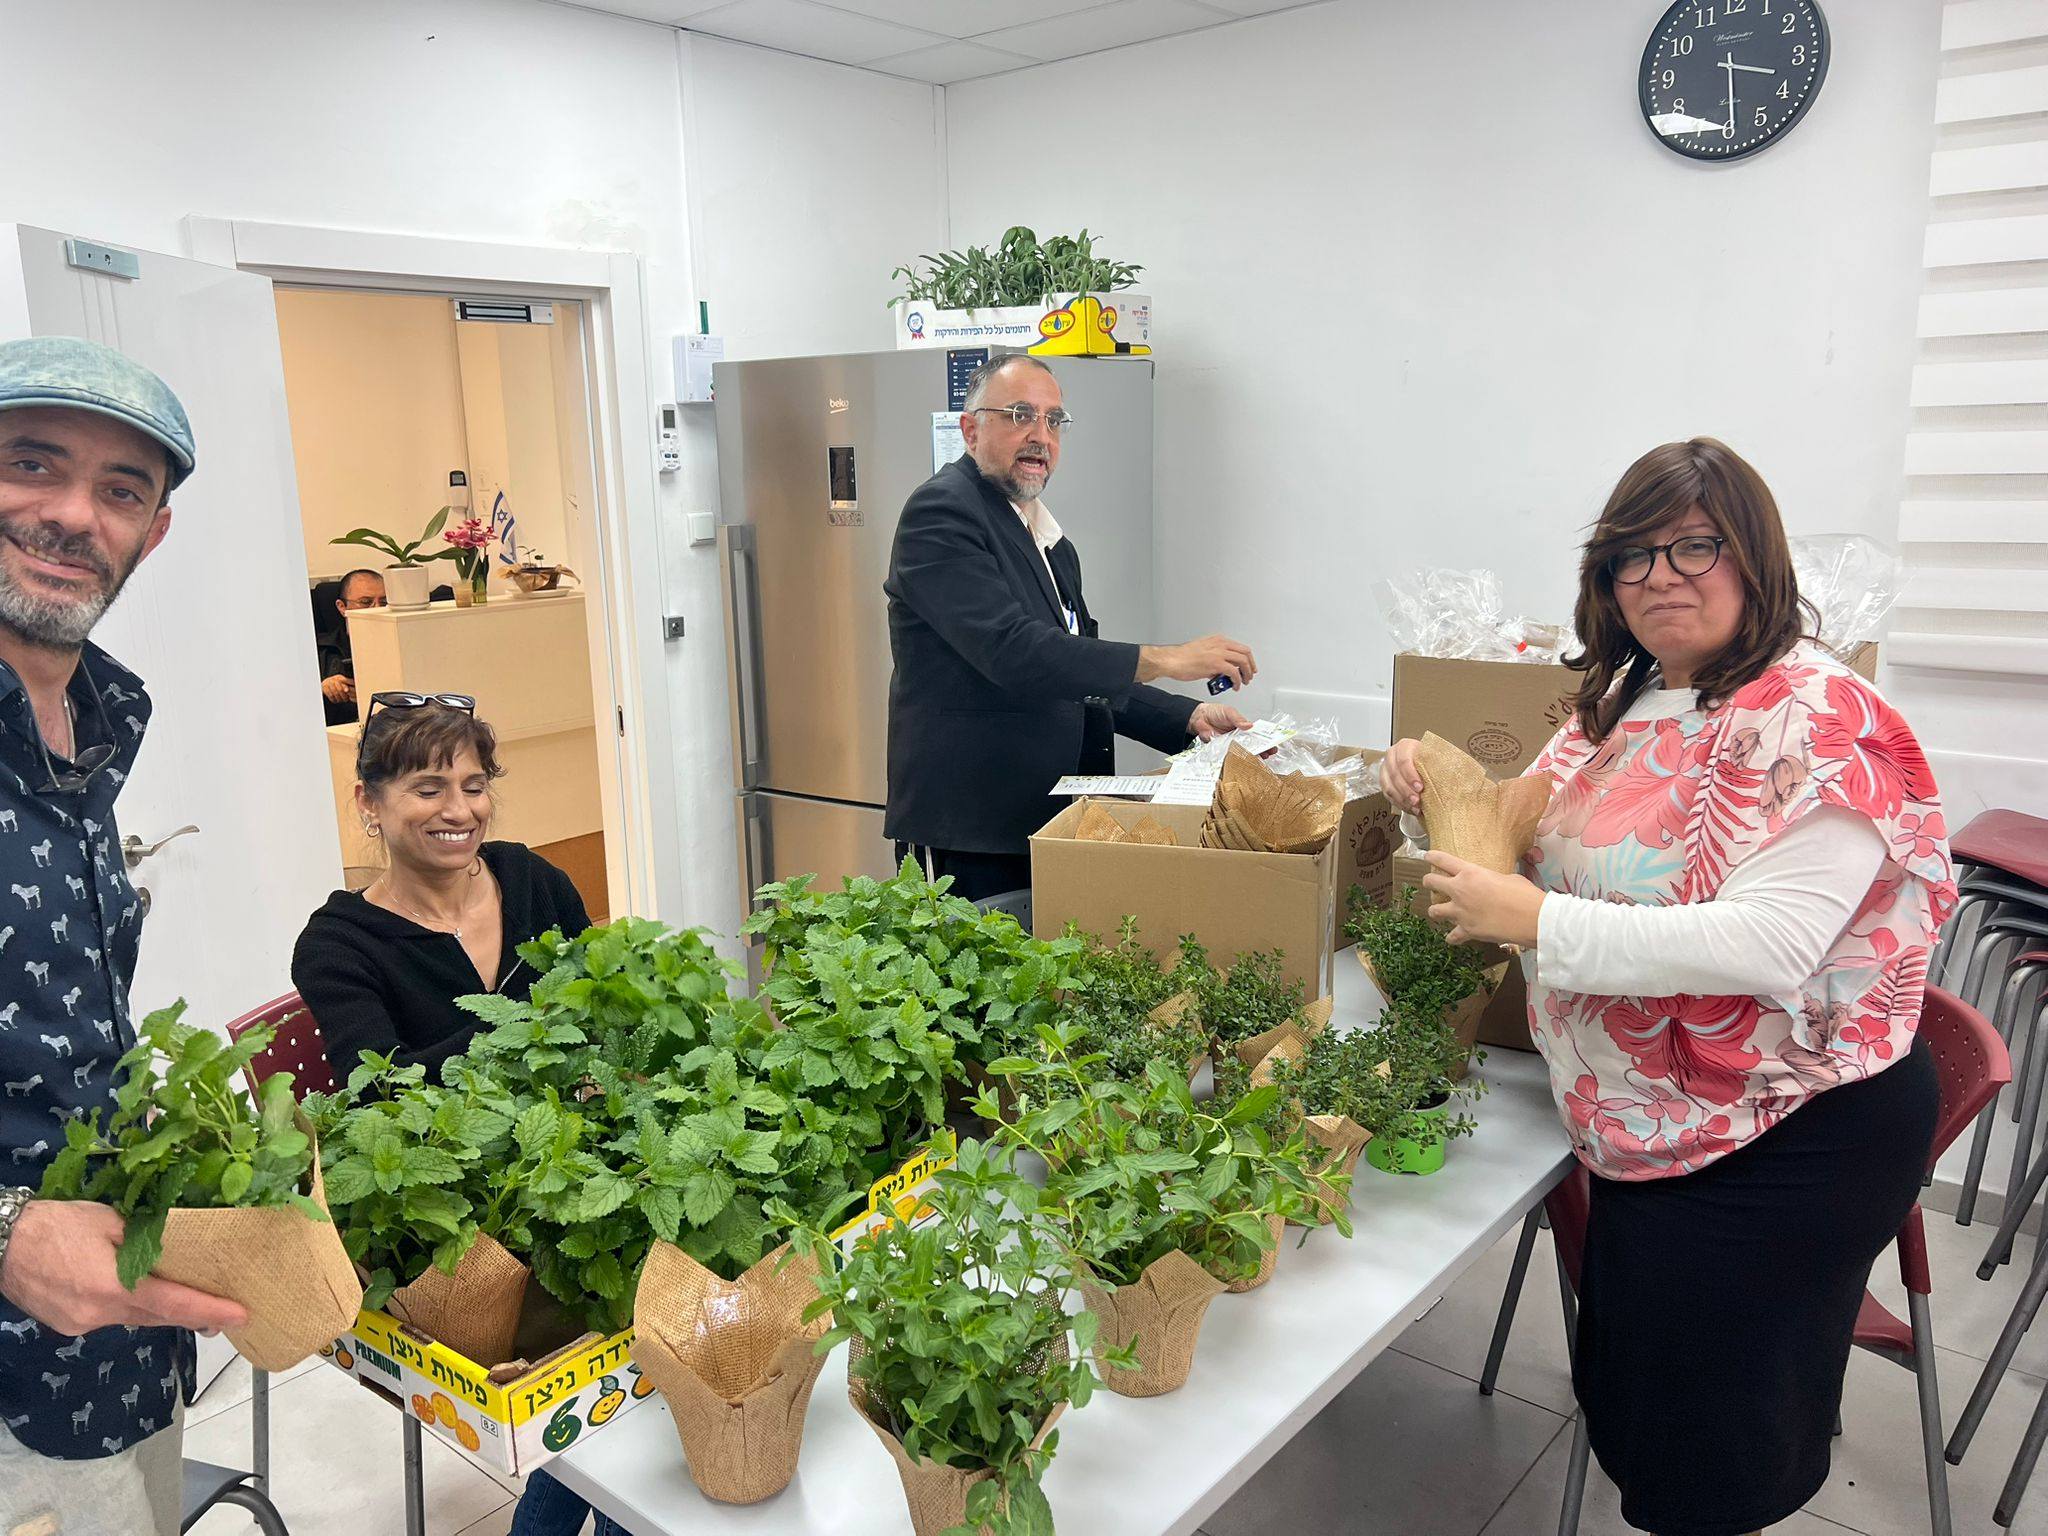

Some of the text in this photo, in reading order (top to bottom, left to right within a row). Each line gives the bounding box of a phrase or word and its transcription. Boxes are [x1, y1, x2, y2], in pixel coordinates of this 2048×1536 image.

[1694, 6, 1717, 28] 11
[1723, 0, 1746, 15] 12
[1761, 0, 1772, 15] 1
[1781, 13, 1796, 34] 2
[1670, 35, 1693, 58] 10
[1791, 45, 1805, 65] 3
[1662, 69, 1675, 89] 9
[1775, 79, 1789, 99] 4
[1672, 98, 1685, 115] 8
[1754, 106, 1767, 126] 5
[1722, 119, 1735, 139] 6
[934, 325, 1031, 338] חתומים על כל הפירות והירקות
[829, 398, 849, 408] beko
[387, 1331, 424, 1369] ניצן
[354, 1339, 402, 1382] PREMIUM
[431, 1357, 488, 1408] פירות
[525, 1370, 576, 1418] ניצן
